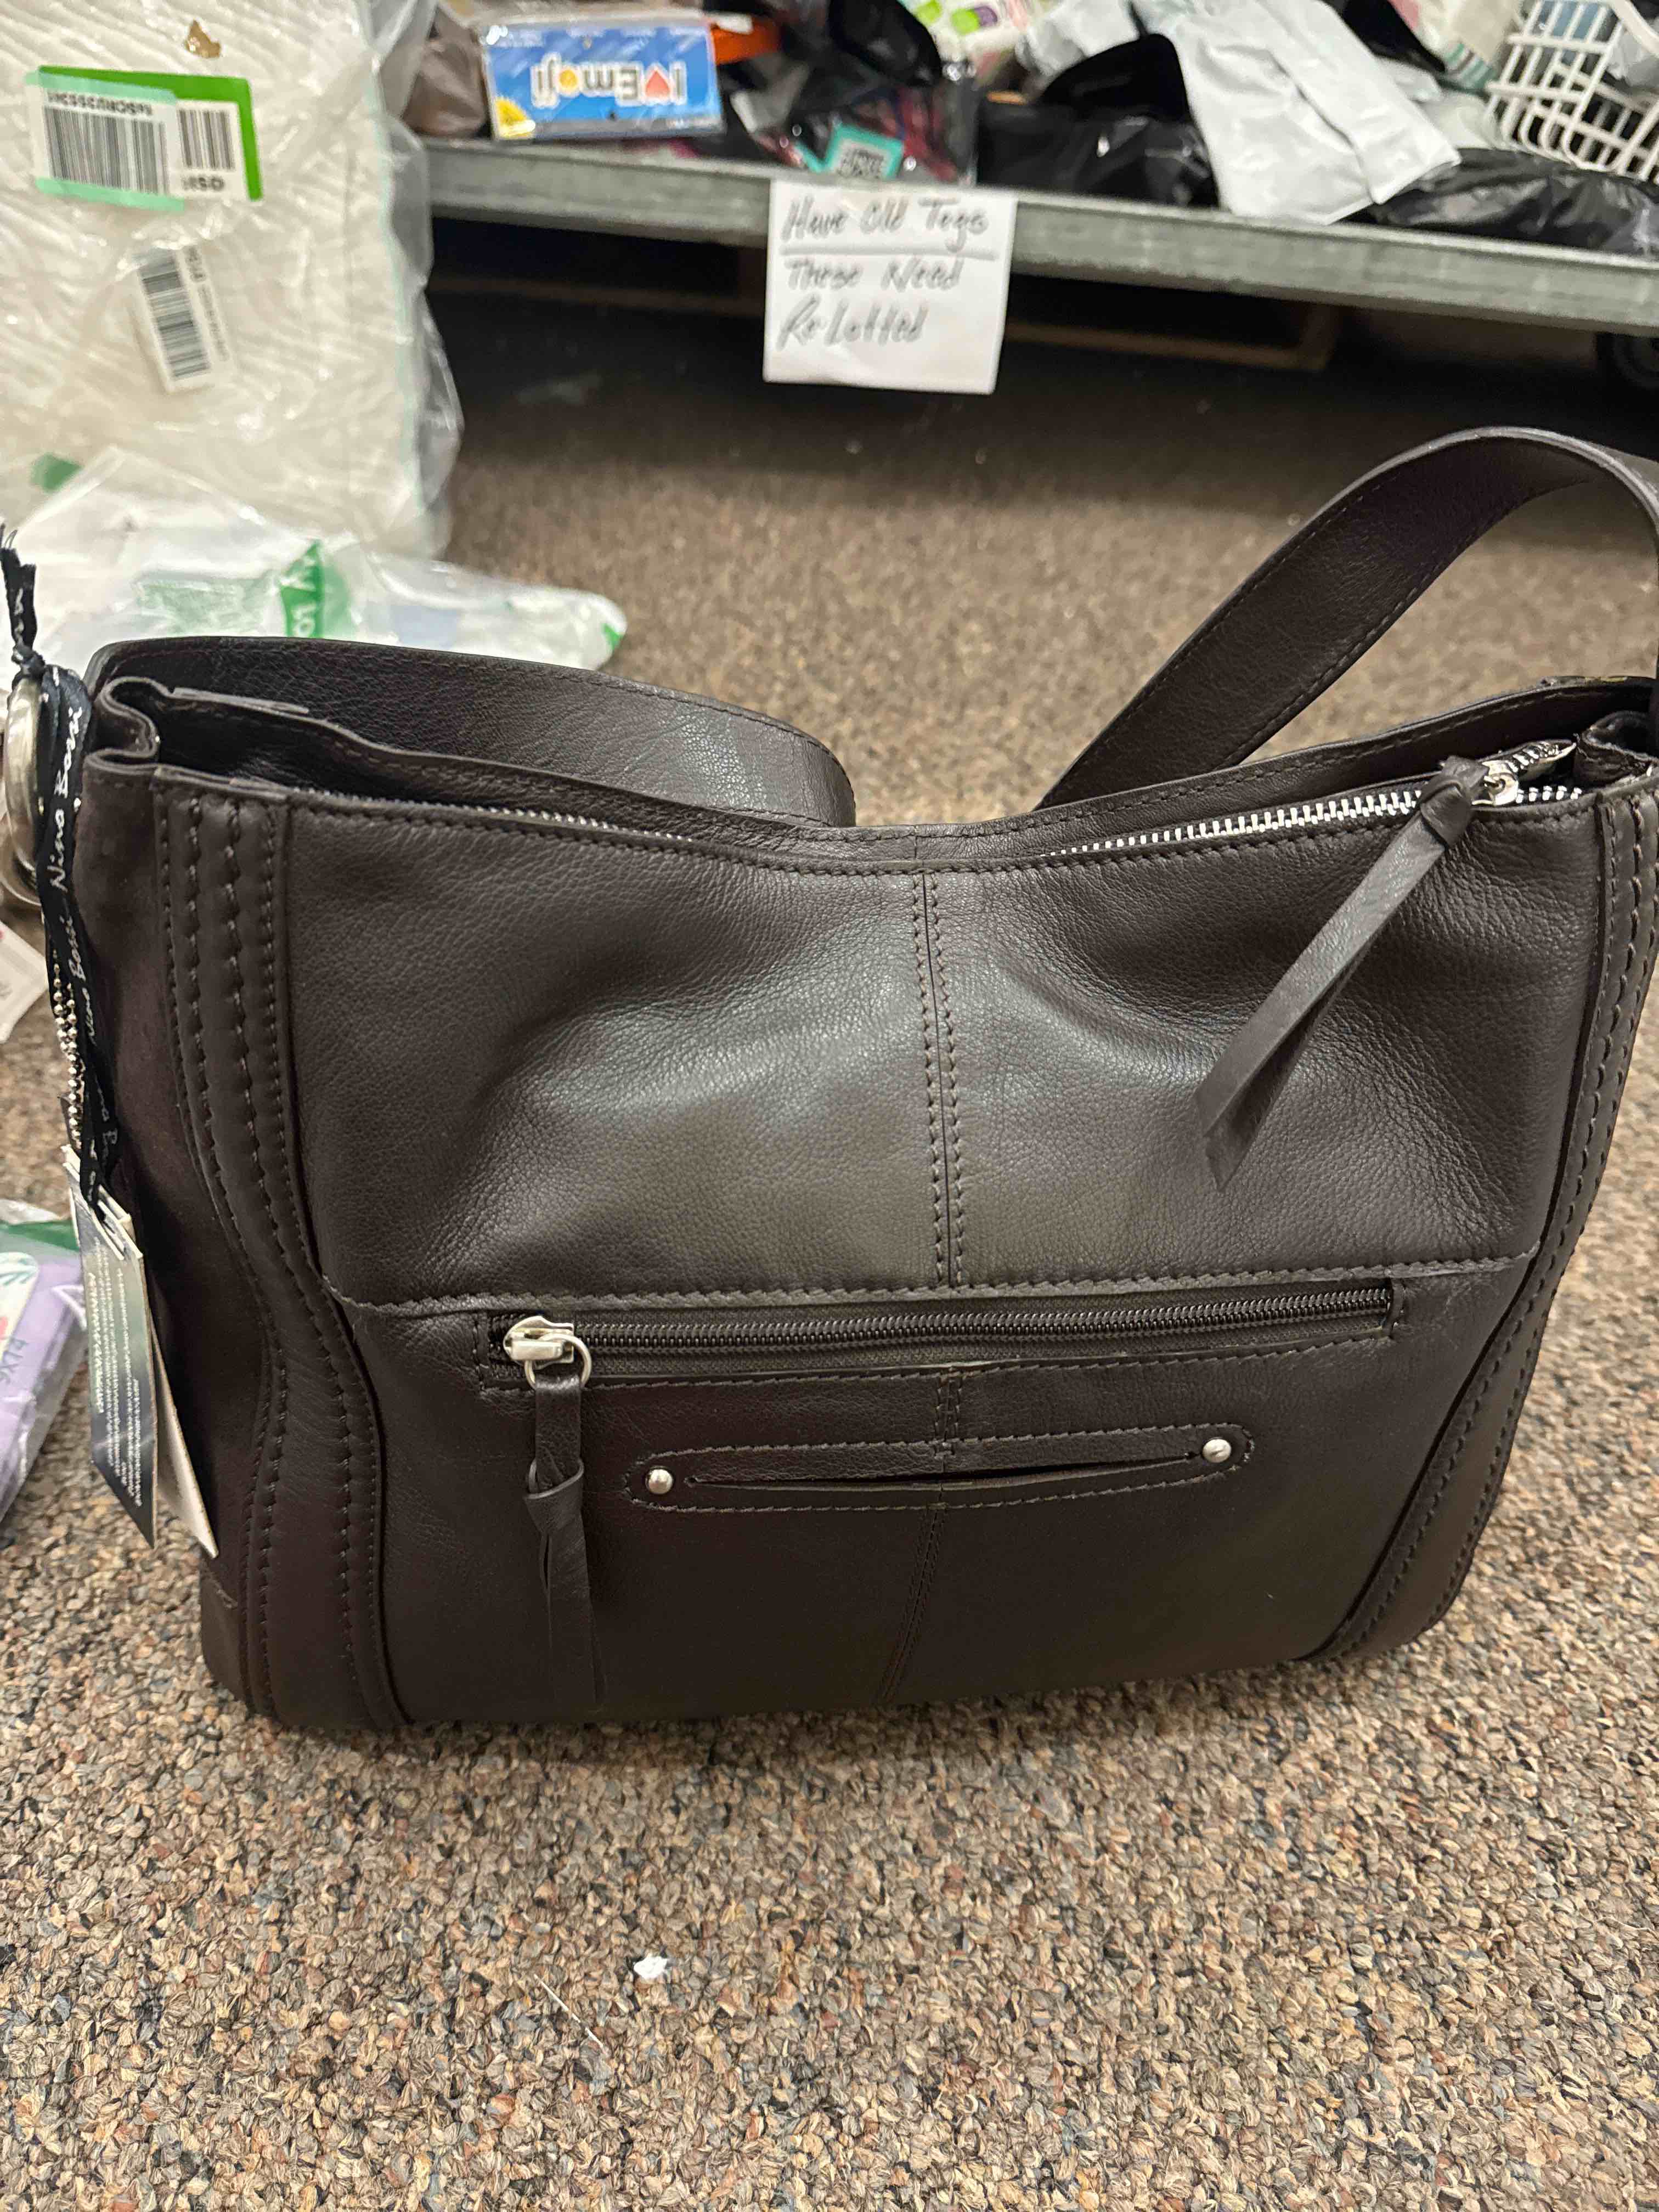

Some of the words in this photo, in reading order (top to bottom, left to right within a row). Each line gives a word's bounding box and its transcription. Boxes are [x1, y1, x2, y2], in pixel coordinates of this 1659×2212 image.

[781, 195, 848, 242] Have
[917, 197, 989, 253] Tags
[785, 258, 864, 291] These
[880, 253, 966, 292] Need
[47, 809, 69, 893] Nino
